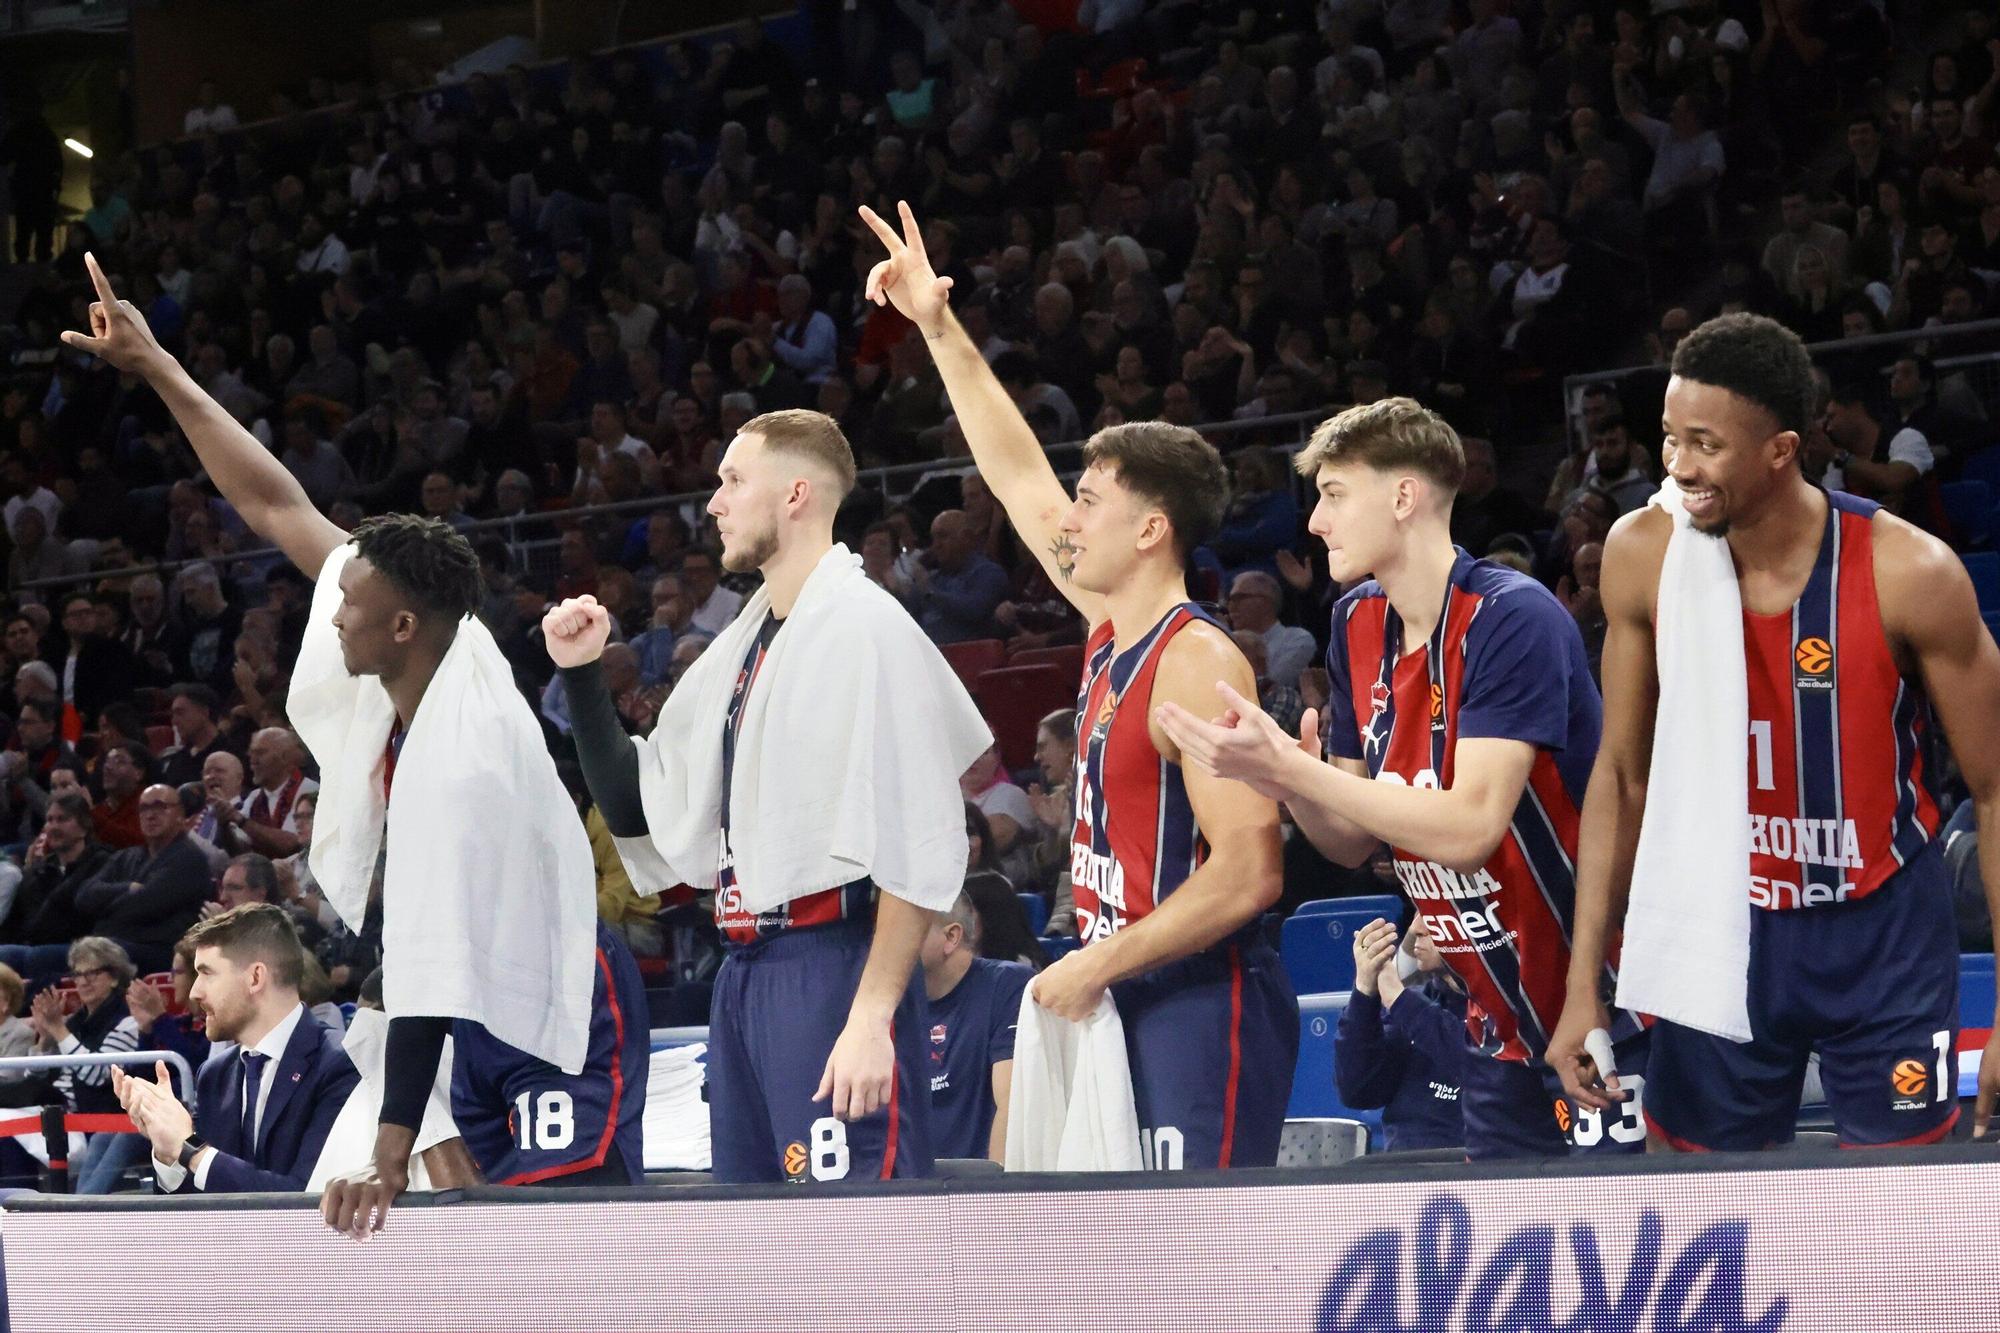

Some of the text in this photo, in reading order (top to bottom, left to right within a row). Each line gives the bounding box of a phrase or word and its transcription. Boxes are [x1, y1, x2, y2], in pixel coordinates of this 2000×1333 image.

[1749, 720, 1776, 790] 1
[1422, 900, 1500, 941] sner
[1475, 930, 1519, 953] eficiente
[1932, 1030, 1950, 1102] 1
[515, 1091, 575, 1150] 18
[810, 1117, 850, 1182] 8
